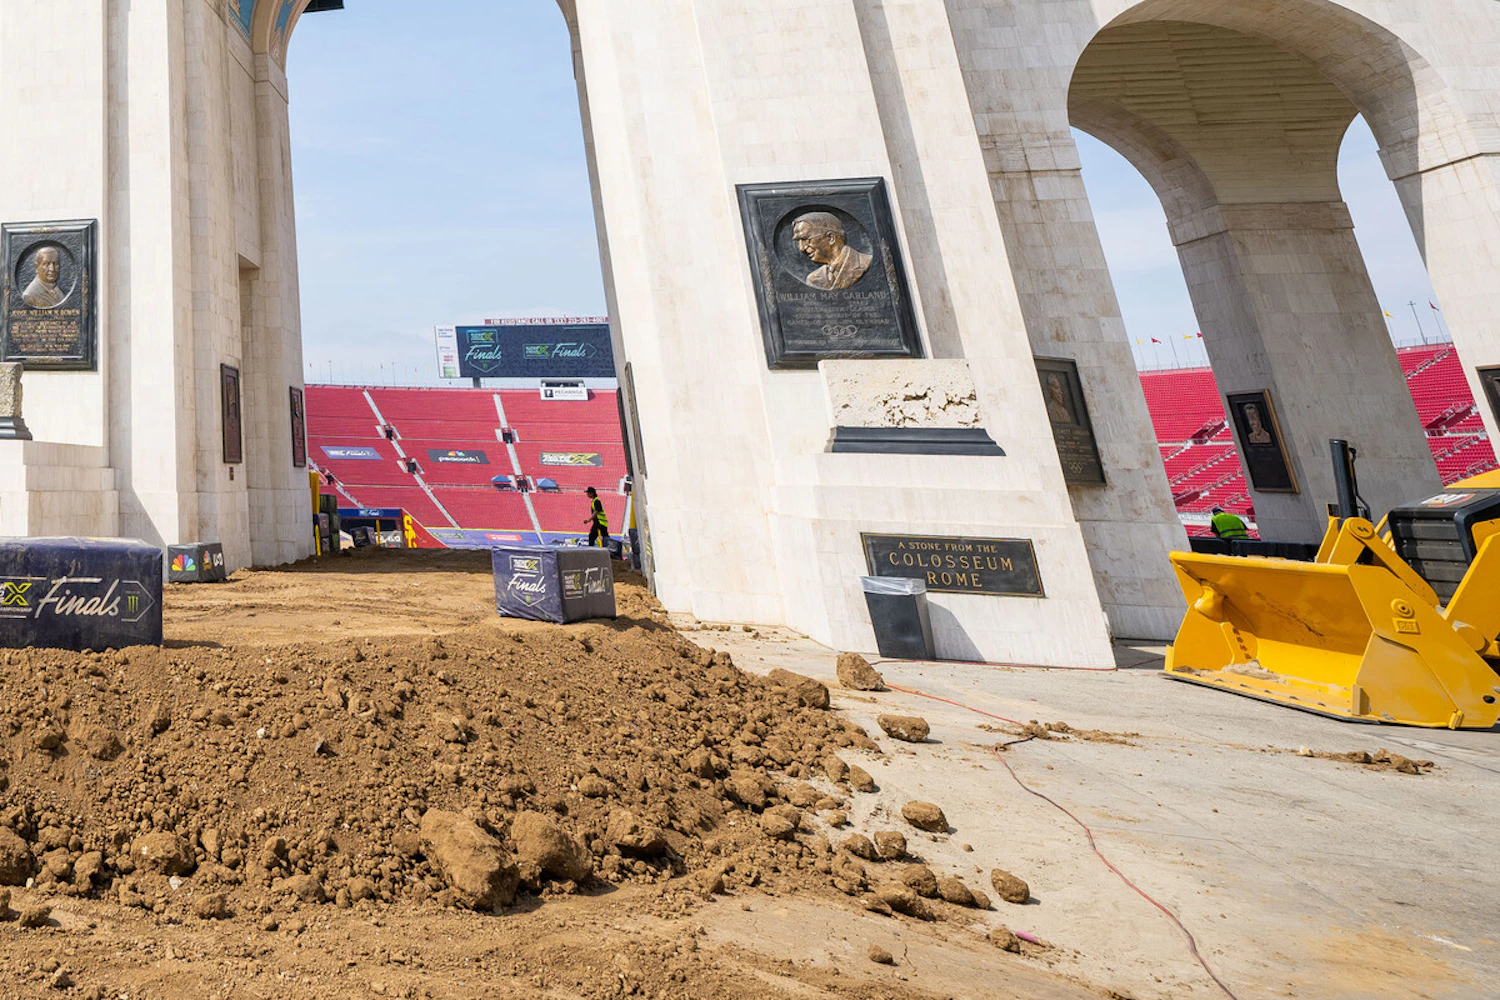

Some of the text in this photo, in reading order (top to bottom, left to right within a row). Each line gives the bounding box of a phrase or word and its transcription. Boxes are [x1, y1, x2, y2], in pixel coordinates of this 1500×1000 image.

[843, 291, 887, 300] GARLAND
[465, 344, 502, 361] Finals
[551, 342, 586, 358] Finals
[908, 542, 942, 550] STONE
[945, 544, 972, 552] FROM
[976, 544, 997, 553] THE
[889, 552, 1014, 571] COLOSSEUM
[507, 573, 546, 594] Finals
[926, 571, 983, 588] ROME
[2, 582, 32, 606] X
[34, 576, 121, 618] Finals
